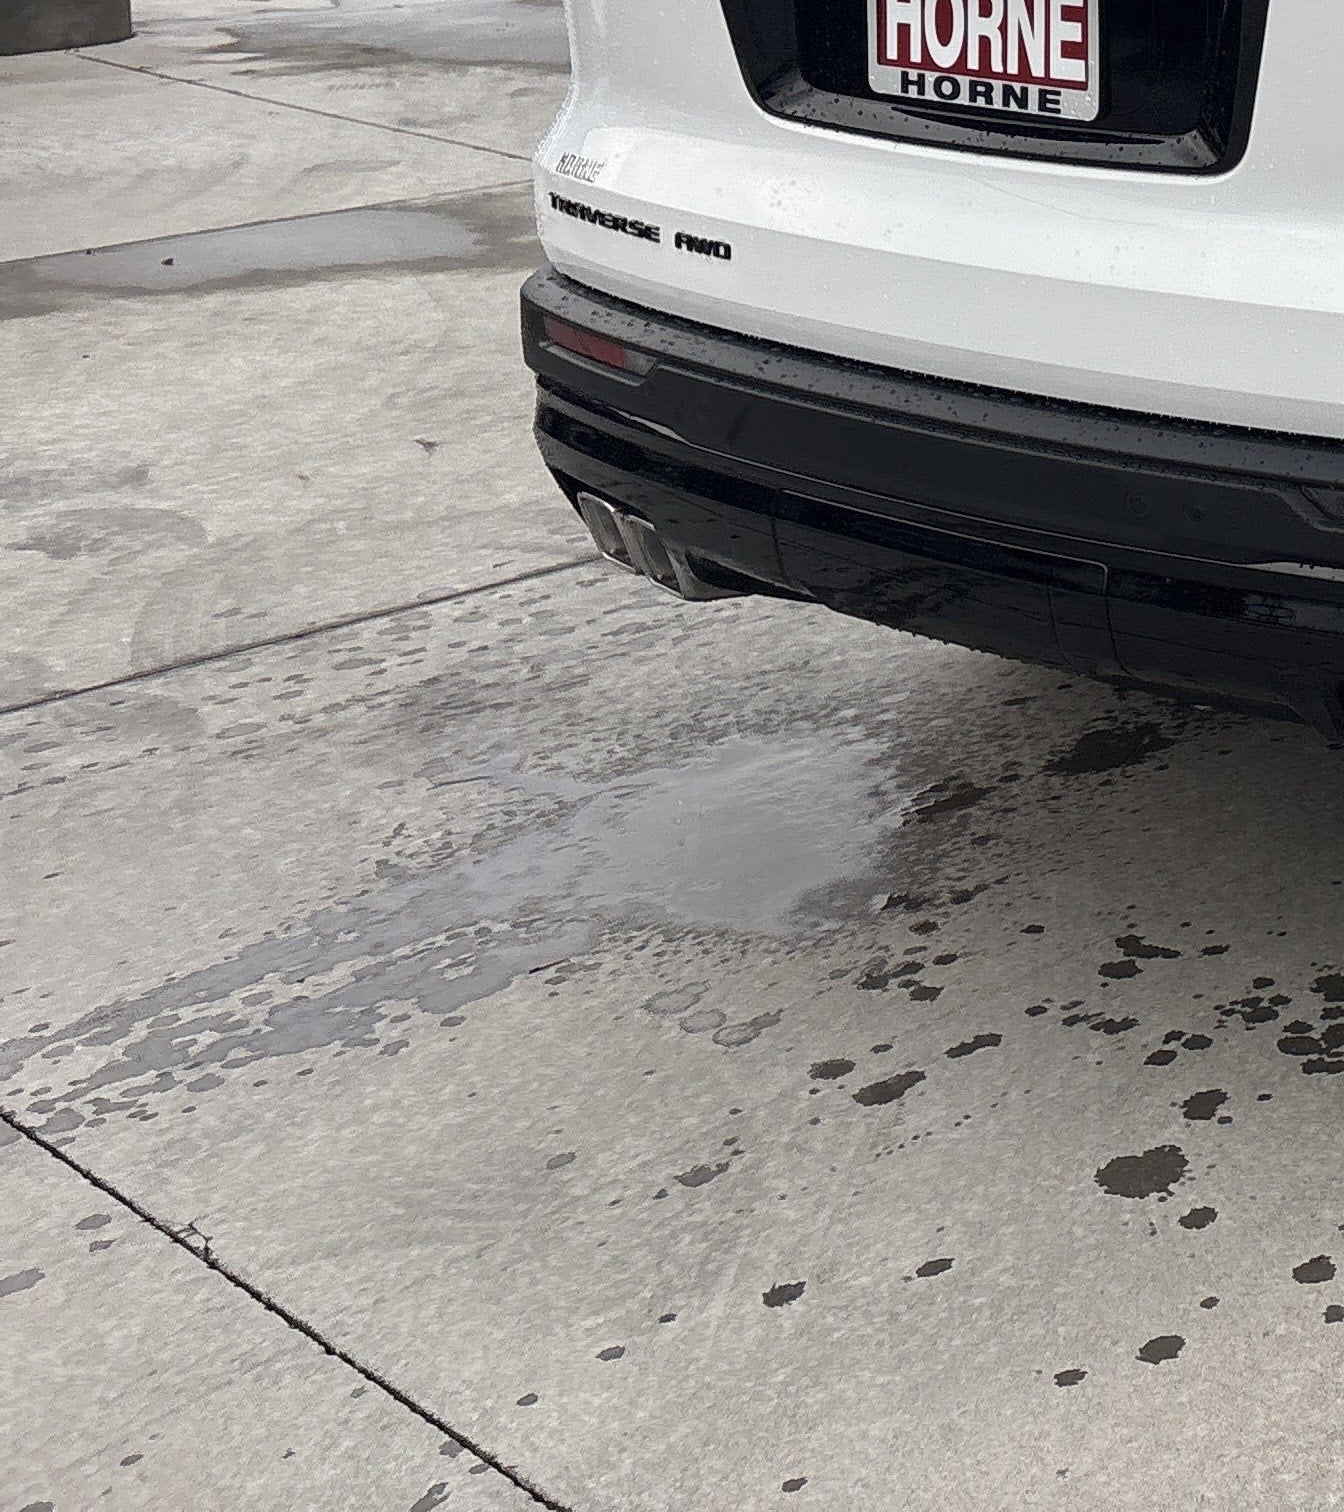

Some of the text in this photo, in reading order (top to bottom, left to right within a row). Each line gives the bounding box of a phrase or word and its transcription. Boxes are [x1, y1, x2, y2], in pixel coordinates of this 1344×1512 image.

[900, 70, 1063, 115] HORNE
[548, 191, 732, 261] TRAVERSE AWD
